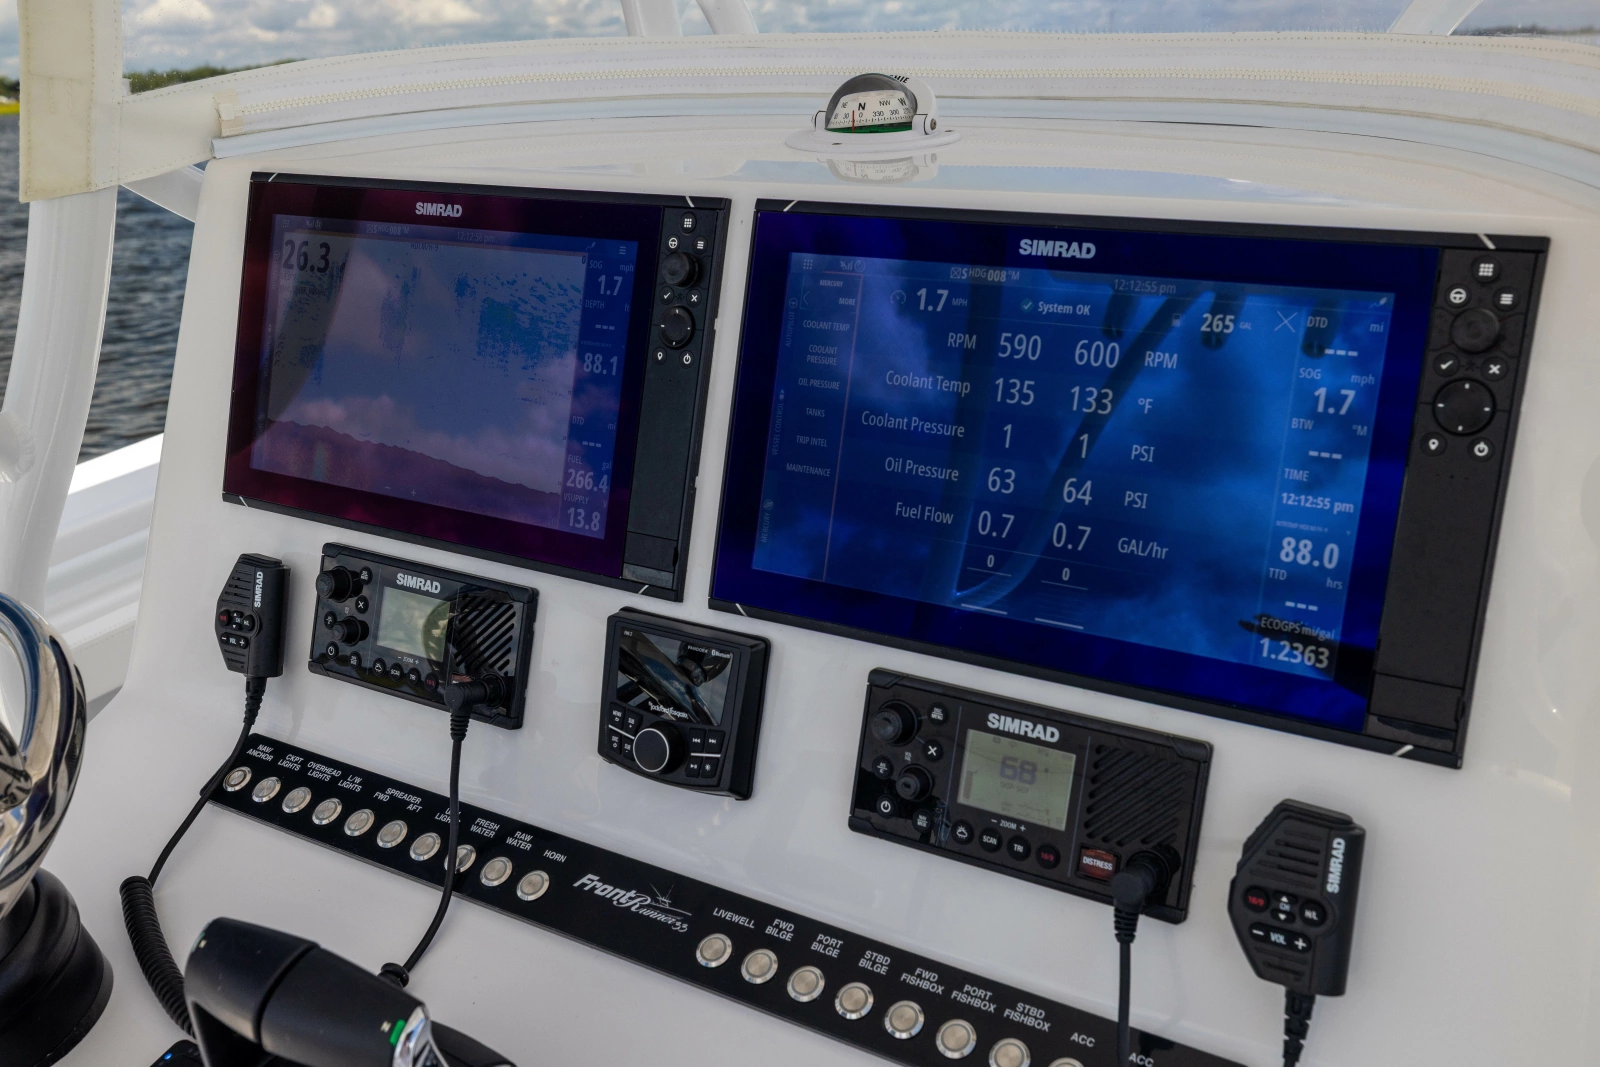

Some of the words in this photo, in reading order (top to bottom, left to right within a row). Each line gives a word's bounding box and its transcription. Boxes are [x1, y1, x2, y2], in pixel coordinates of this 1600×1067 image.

[858, 102, 867, 111] N
[879, 99, 891, 107] NW
[898, 97, 907, 106] W
[415, 201, 463, 219] SIMRAD
[283, 239, 331, 274] 26.3
[1019, 238, 1096, 260] SIMRAD
[589, 259, 603, 270] SOG
[620, 264, 634, 274] mph
[968, 268, 986, 278] HDG
[988, 270, 1006, 282] 008
[598, 274, 624, 296] 1.7
[819, 279, 844, 288] MERCURY
[1112, 279, 1158, 294] 12:12:55
[1159, 282, 1177, 295] pm
[585, 300, 605, 310] DEPTH
[624, 304, 630, 312] ft
[838, 297, 856, 306] MORE
[916, 287, 949, 312] 1.7
[952, 298, 968, 307] MPH
[1038, 300, 1074, 316] System
[1076, 304, 1091, 316] OK
[785, 312, 796, 348] AUTOPILOT
[802, 319, 832, 330] COOLANT
[832, 322, 850, 332] TEMP
[1200, 312, 1236, 334] 265
[1239, 321, 1252, 330] GAL
[1306, 316, 1328, 329] DTD
[1370, 321, 1384, 332] mi
[808, 344, 838, 355] COOLANT
[947, 332, 977, 350] RPM
[998, 331, 1042, 360] 590
[1074, 340, 1120, 369] 600
[1144, 350, 1178, 370] RPM
[583, 352, 618, 376] 88.1
[806, 355, 838, 366] PRESSURE
[798, 378, 808, 387] OIL
[810, 379, 840, 390] PRESSURE
[1299, 367, 1322, 380] SOG
[1350, 374, 1375, 386] mph
[886, 370, 933, 390] Coolant
[936, 376, 971, 398] Temp
[994, 377, 1036, 406] 135
[1070, 385, 1114, 416] 133
[1138, 396, 1154, 414] °F
[1313, 386, 1356, 416] 1.7
[774, 402, 784, 434] CONTROL
[806, 407, 826, 418] TANKS
[572, 416, 584, 426] DTD
[1291, 418, 1314, 431] BTW
[1352, 424, 1368, 436] °M
[772, 432, 780, 456] VESSEL
[796, 435, 810, 445] TRIP
[810, 436, 828, 448] INTEL
[861, 410, 908, 428] Coolant
[911, 416, 965, 438] Pressure
[1003, 424, 1012, 449] 1
[1079, 433, 1088, 459] 1
[1130, 444, 1155, 463] PSI
[568, 454, 582, 464] FUEL
[602, 461, 612, 470] gal
[786, 462, 831, 478] MAINTENANCE
[566, 468, 610, 492] 266.4
[884, 456, 903, 474] Oil
[905, 460, 959, 482] Pressure
[988, 467, 1016, 494] 63
[1062, 478, 1092, 506] 64
[1124, 491, 1148, 510] PSI
[1284, 468, 1310, 482] TIME
[564, 492, 590, 504] VSUPPLY
[1281, 492, 1331, 510] 12:12:55
[1333, 500, 1354, 515] pm
[567, 507, 601, 532] 13.8
[760, 512, 770, 543] MERCURY
[895, 502, 921, 520] Fuel
[924, 505, 954, 526] Flow
[978, 510, 1016, 538] 0.7
[1052, 522, 1092, 552] 0.7
[1118, 537, 1169, 560] GAL/hr
[1279, 536, 1340, 570] 88.0
[987, 554, 995, 568] 0
[1062, 568, 1070, 582] 0
[396, 572, 442, 594] SIMRAD
[1268, 567, 1287, 582] TTD
[1326, 577, 1342, 590] hrs
[254, 571, 264, 608] SIMRAD
[1260, 616, 1300, 634] ECOGPS
[1302, 626, 1336, 642] mi/gal
[1259, 636, 1330, 669] 1.2363
[986, 712, 1060, 743] SIMRAD
[246, 748, 274, 762] ANCHOR
[257, 744, 274, 754] NAV/
[278, 759, 302, 772] LIGHTS
[285, 754, 304, 764] CKPT
[307, 761, 342, 778] OVERHEAD
[308, 769, 332, 782] LIGHTS
[1000, 755, 1038, 785] 68
[338, 780, 362, 792] LIGHTS
[347, 774, 362, 784] L/W
[373, 792, 390, 802] FWD
[406, 803, 422, 814] AFT
[385, 787, 422, 805] SPREADER
[434, 812, 461, 824] LIGH
[474, 818, 500, 832] FRESH
[1000, 820, 1017, 831] ZOOM
[470, 824, 496, 839] WATER
[514, 831, 534, 842] RAW
[506, 836, 532, 852] WATER
[982, 834, 998, 846] SCAN
[1013, 843, 1024, 853] TRI
[543, 850, 568, 864] HORN
[1082, 856, 1113, 872] DISTRESS
[1326, 838, 1346, 894] SIMRAD
[1280, 902, 1290, 912] CH
[1304, 909, 1318, 921] H/L
[672, 921, 689, 932] 33
[712, 908, 755, 929] LIVEWELL
[772, 918, 795, 932] FWD
[765, 926, 794, 942] BILGE
[816, 934, 844, 948] PORT
[1270, 932, 1286, 946] VOL
[810, 941, 840, 958] BILGE
[864, 950, 891, 966] STBD
[858, 958, 889, 976] BILGE
[914, 967, 938, 982] FWD
[900, 973, 945, 996] FISHBOX
[963, 984, 993, 1001] PORT
[950, 990, 998, 1014] FISHBOX
[1016, 1002, 1046, 1020] STBD
[380, 1021, 391, 1033] N
[1003, 1008, 1052, 1032] FISHBOX
[1070, 1032, 1096, 1048] ACC
[1128, 1052, 1154, 1067] ACC
